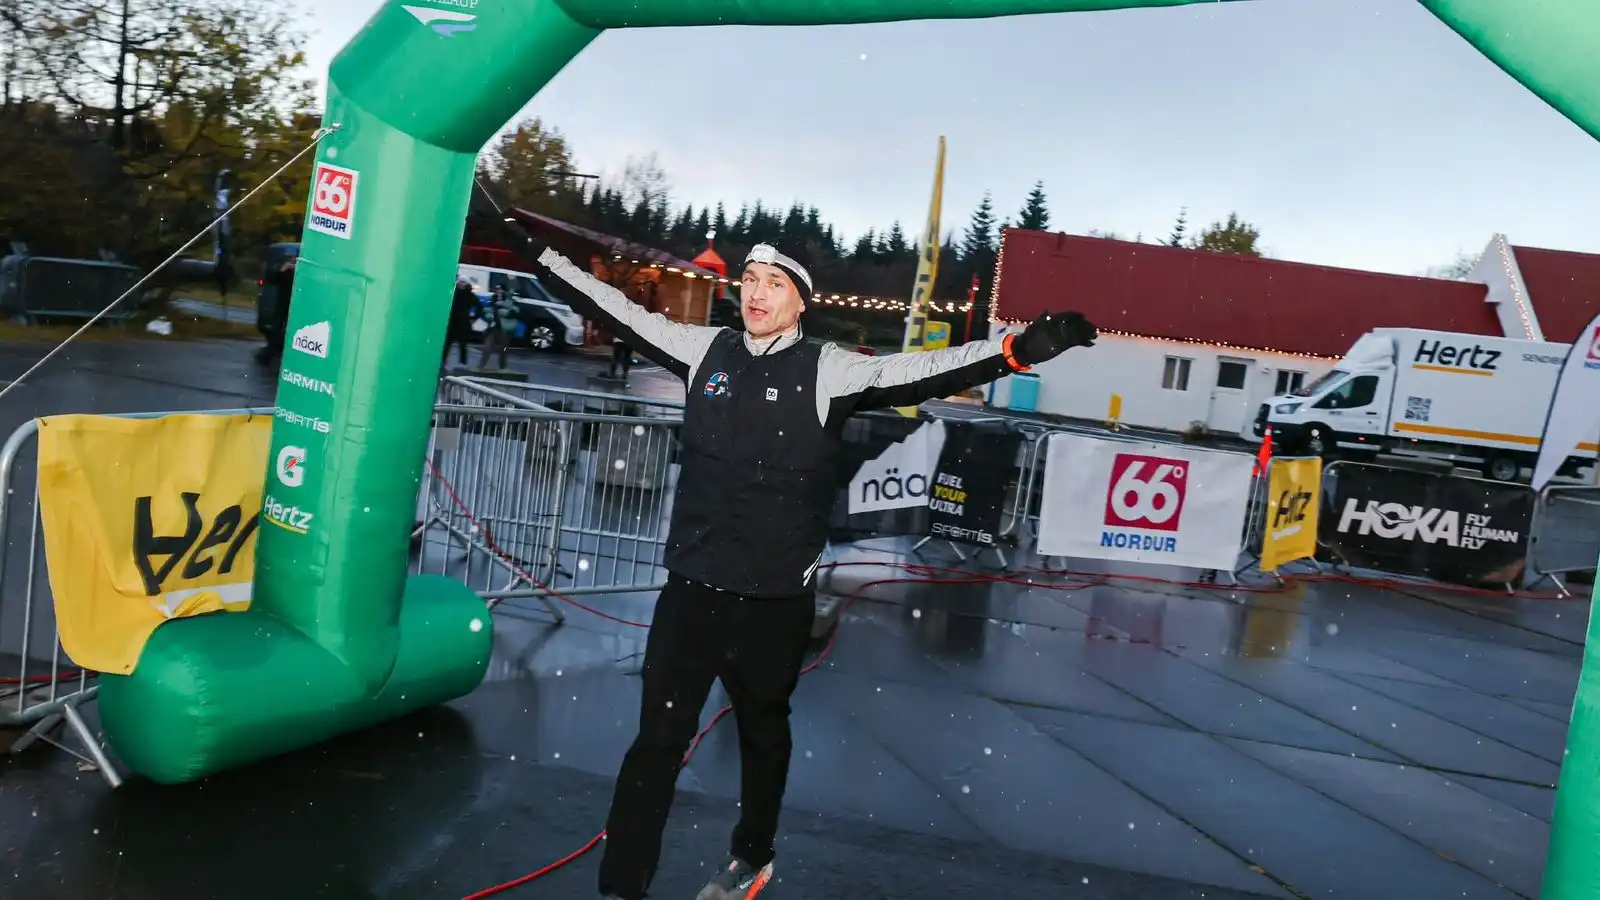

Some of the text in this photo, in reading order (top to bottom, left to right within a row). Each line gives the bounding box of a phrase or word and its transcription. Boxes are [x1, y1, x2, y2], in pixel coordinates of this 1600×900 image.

[294, 335, 323, 353] näak
[1414, 339, 1502, 371] Hertz
[276, 445, 306, 488] G
[865, 467, 930, 504] näa
[936, 472, 964, 489] FUEL
[934, 484, 968, 504] YOUR
[264, 495, 313, 530] Hertz
[928, 497, 964, 517] ULTRA
[1337, 498, 1460, 547] HOKA
[1465, 512, 1493, 527] FLY
[133, 492, 260, 596] Her
[1459, 535, 1488, 550] FLY
[1461, 524, 1519, 544] HUMAN
